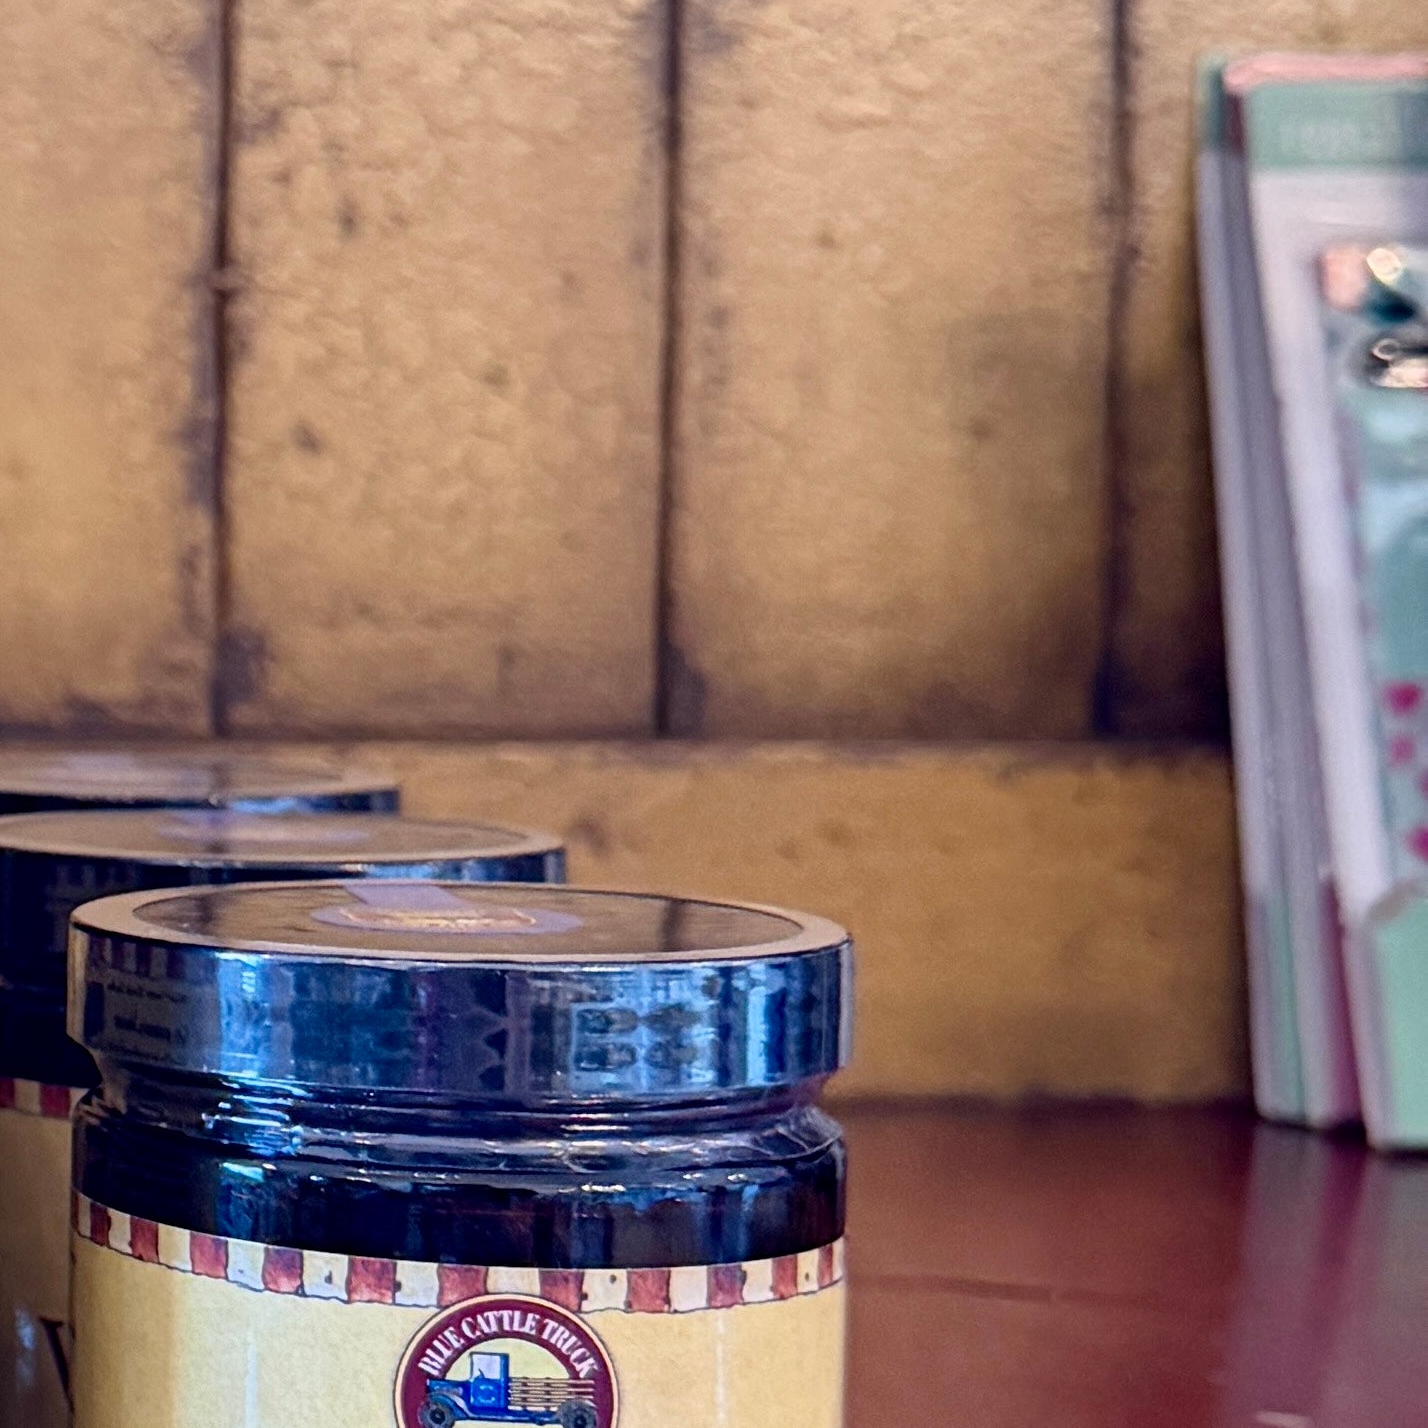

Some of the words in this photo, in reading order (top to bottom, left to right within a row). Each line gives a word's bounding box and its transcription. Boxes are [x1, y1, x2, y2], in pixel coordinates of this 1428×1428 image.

[417, 1325, 465, 1377] BLUE
[461, 1309, 541, 1339] CATTLE
[541, 1316, 599, 1379] TRUCK
